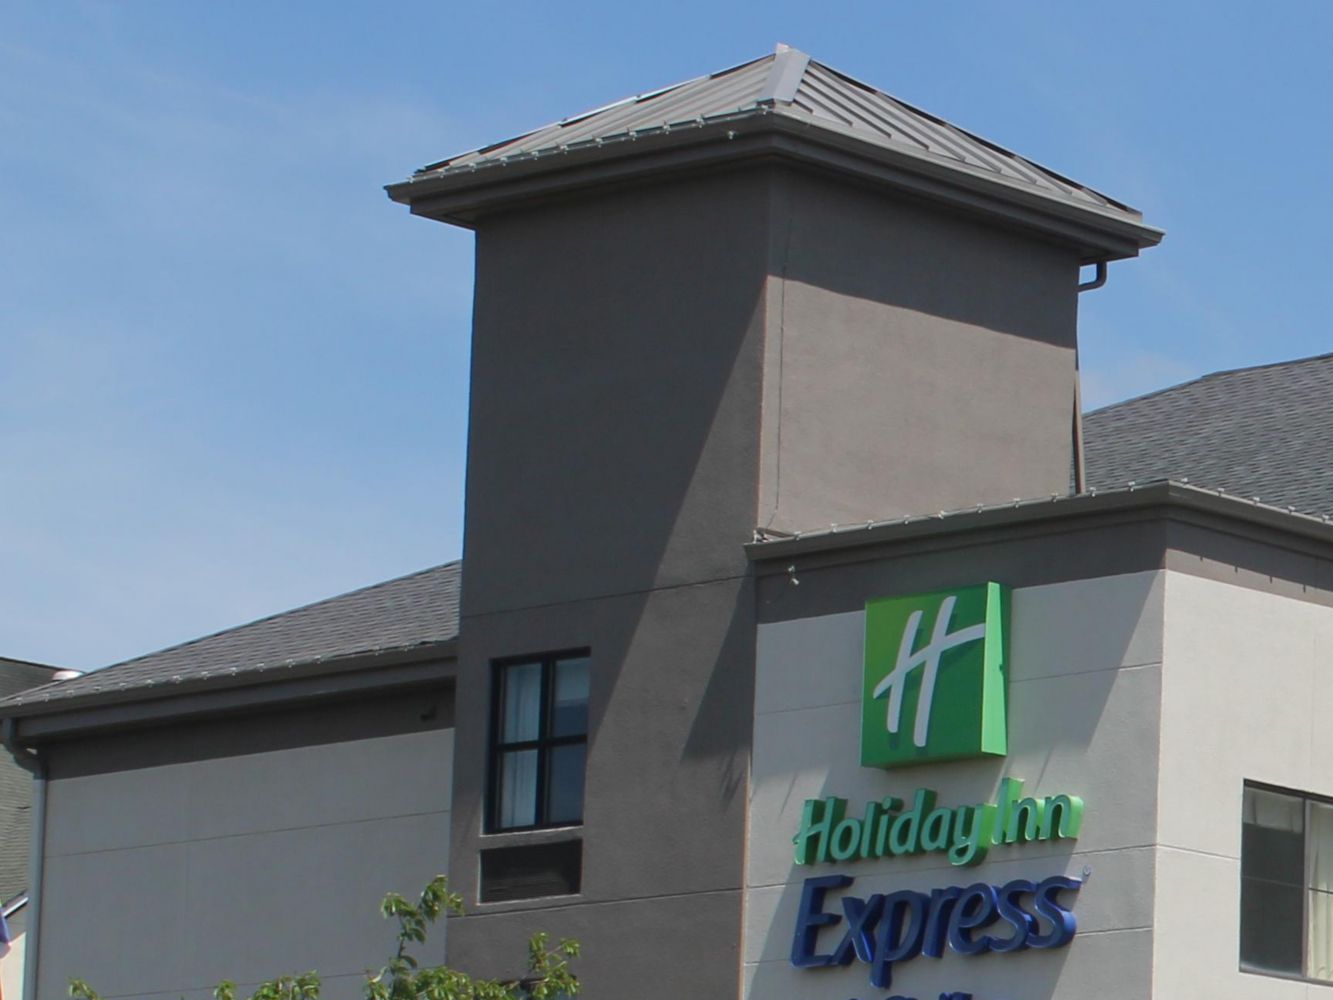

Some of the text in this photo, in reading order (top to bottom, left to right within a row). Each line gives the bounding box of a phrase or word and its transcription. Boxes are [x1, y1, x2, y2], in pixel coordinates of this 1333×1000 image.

[793, 777, 1084, 866] Holiday Inn
[790, 875, 1081, 988] Express
